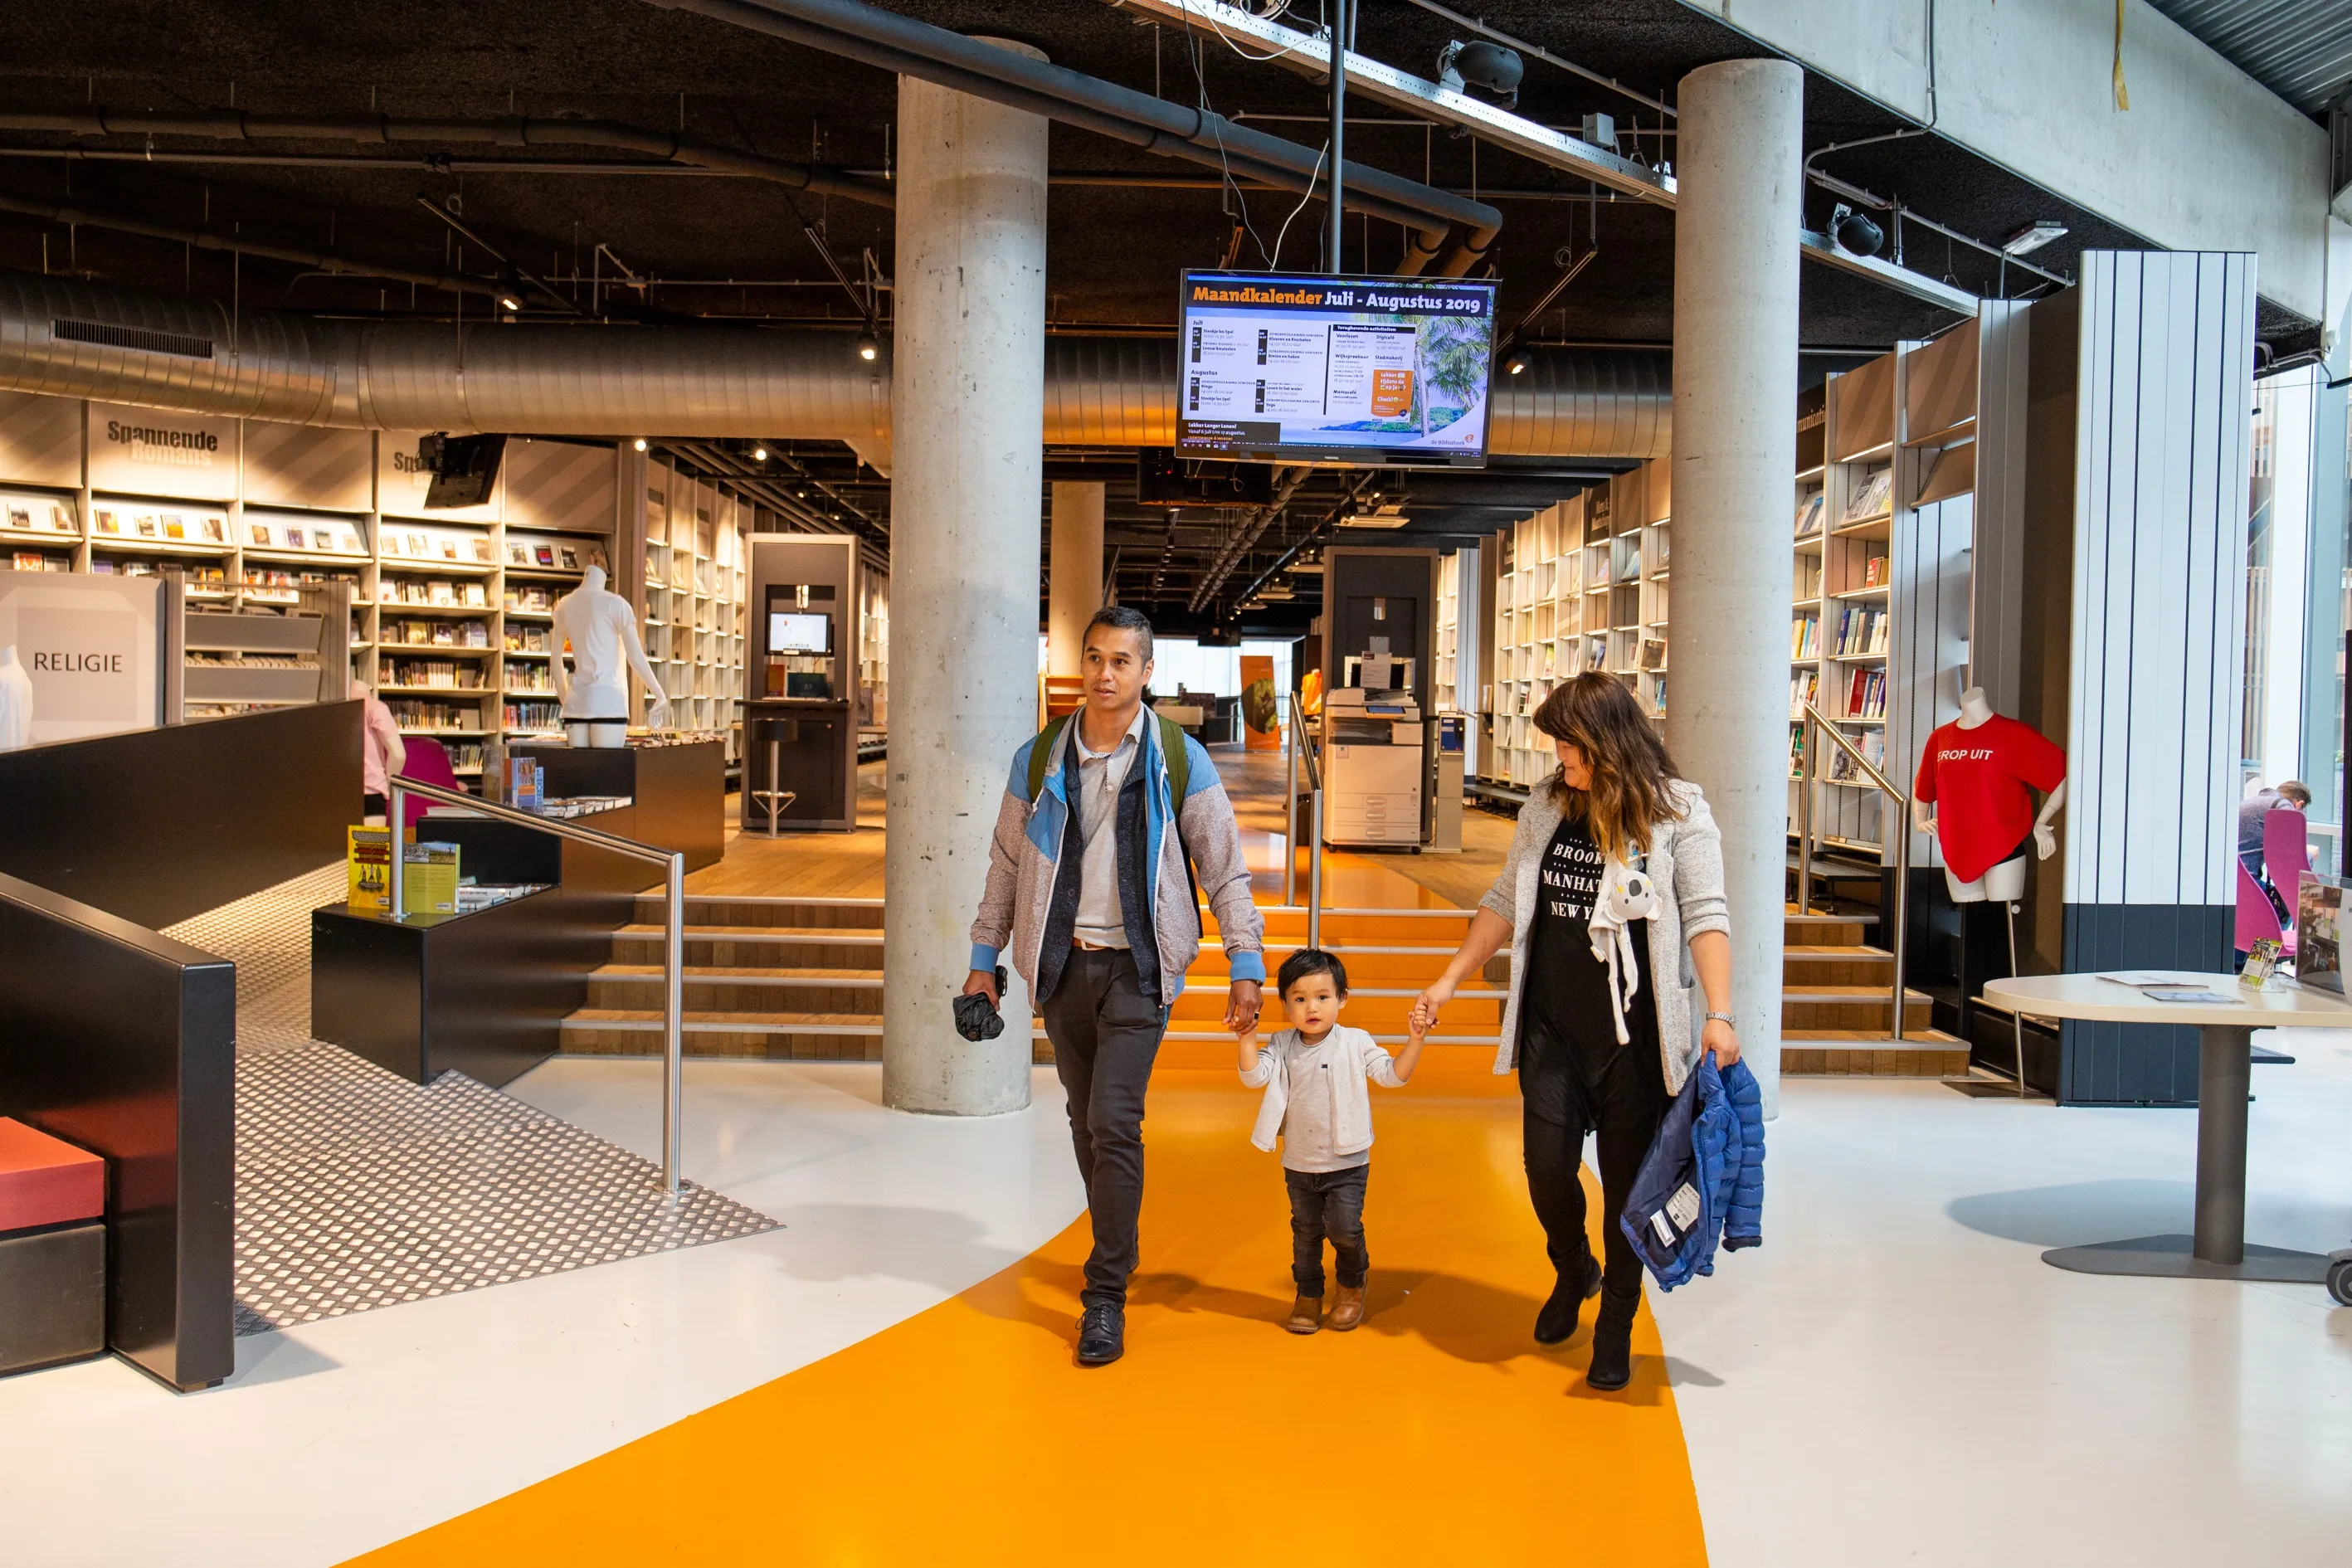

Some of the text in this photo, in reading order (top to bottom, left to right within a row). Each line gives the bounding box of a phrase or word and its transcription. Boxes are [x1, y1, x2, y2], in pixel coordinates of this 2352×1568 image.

[1193, 287, 1322, 305] Maandkalender
[1324, 291, 1354, 307] Juli
[1366, 294, 1443, 312] Augustus
[1446, 299, 1481, 314] 2019
[108, 421, 218, 452] Spannende
[131, 439, 213, 467] Romans
[34, 651, 123, 673] RELIGIE
[1970, 749, 1994, 761] UIT
[1552, 843, 1606, 865] BROOK
[1551, 901, 1581, 918] NEW
